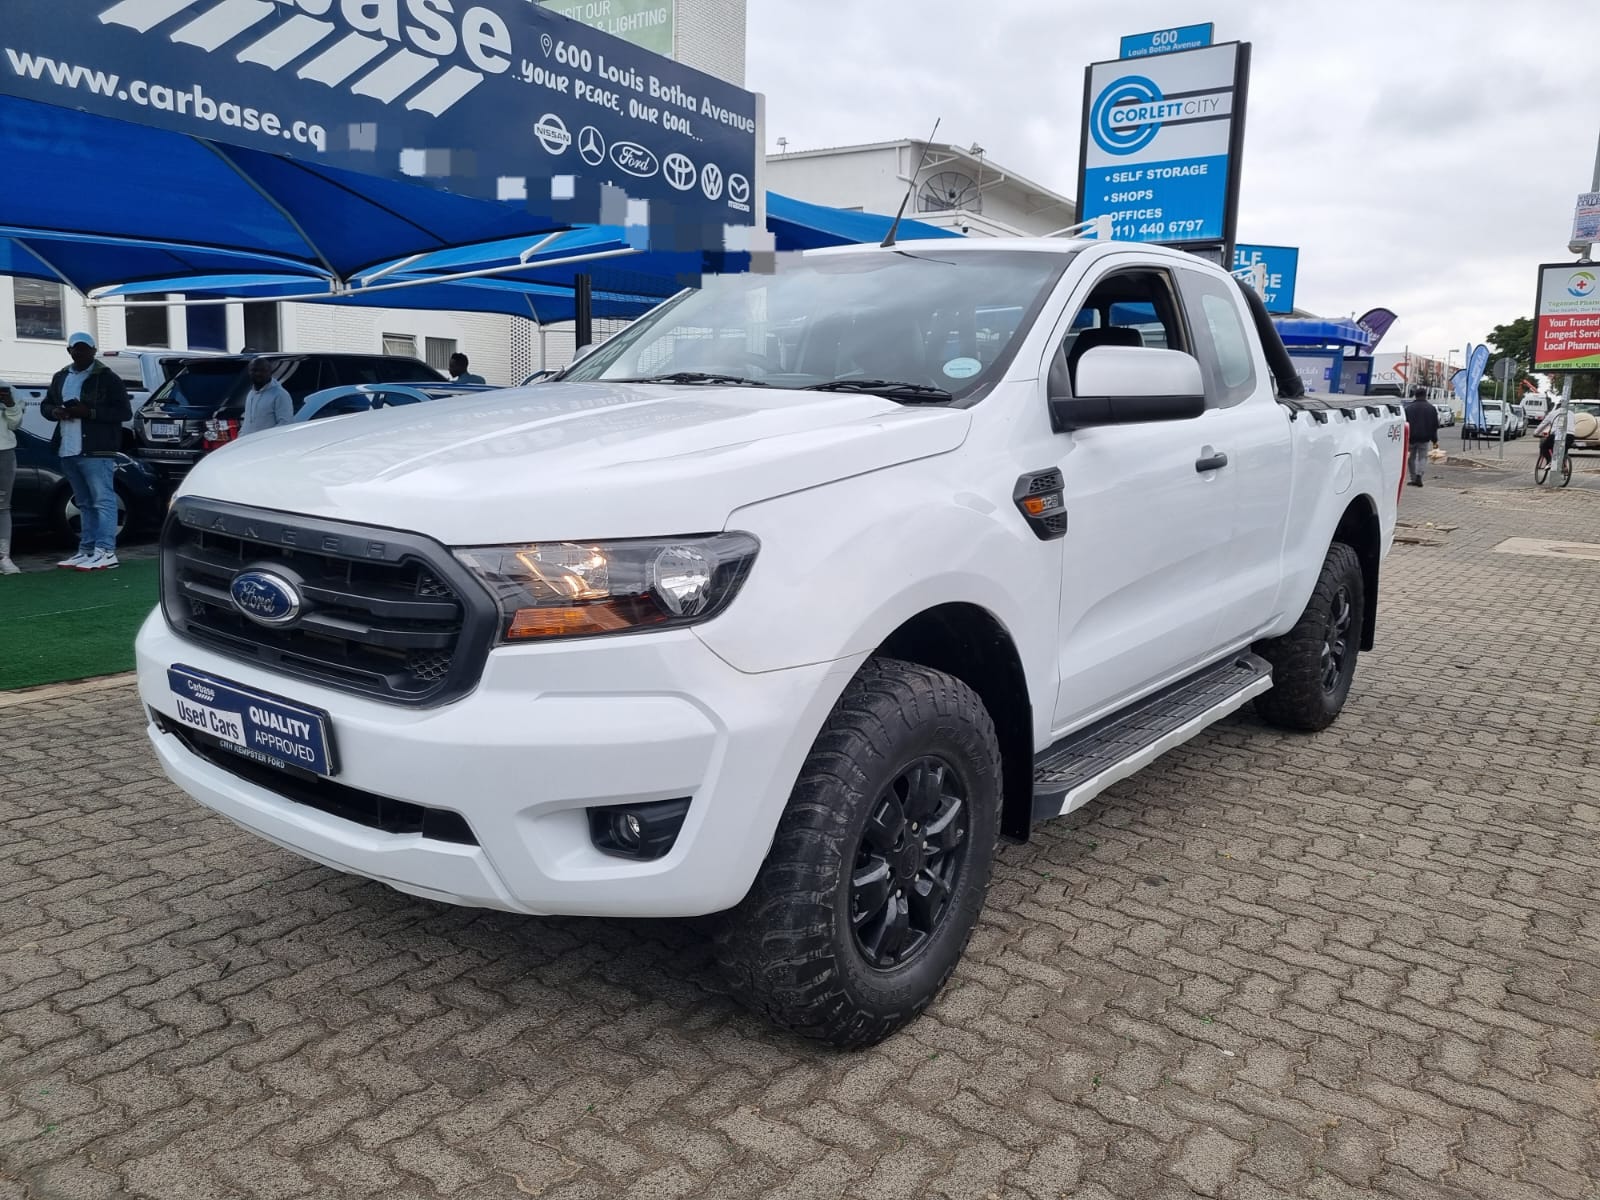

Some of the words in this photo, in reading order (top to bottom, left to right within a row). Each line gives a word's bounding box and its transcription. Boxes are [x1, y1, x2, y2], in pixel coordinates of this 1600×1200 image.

[586, 1, 611, 19] OUR
[608, 8, 667, 34] LIGHTING
[1152, 30, 1178, 46] 600
[1128, 47, 1148, 57] Louis
[1149, 44, 1171, 54] Botha
[1172, 40, 1201, 51] Avenue
[555, 40, 592, 73] 600
[598, 56, 644, 92] Louis
[649, 75, 697, 112] Botha
[701, 96, 755, 134] Avenue
[575, 79, 624, 117] PEACE,
[629, 99, 659, 125] OUR
[536, 126, 570, 143] NISSAN
[619, 146, 650, 172] Ford
[1112, 168, 1143, 184] SELF
[1147, 164, 1208, 181] STORAGE
[1111, 190, 1153, 203] SHOPS
[1110, 208, 1163, 222] OFFICES
[1139, 221, 1165, 235] 440
[1168, 219, 1204, 232] 6797
[1549, 318, 1567, 328] Your
[1569, 317, 1600, 327] Trusted
[1544, 330, 1577, 341] Longest
[1544, 341, 1567, 351] Local
[239, 579, 276, 614] Ford
[187, 679, 216, 698] Carbase
[176, 699, 208, 729] Used
[209, 711, 240, 741] Cars
[249, 706, 311, 741] QUALITY
[255, 729, 316, 763] APPROVED
[267, 755, 285, 769] FORD
